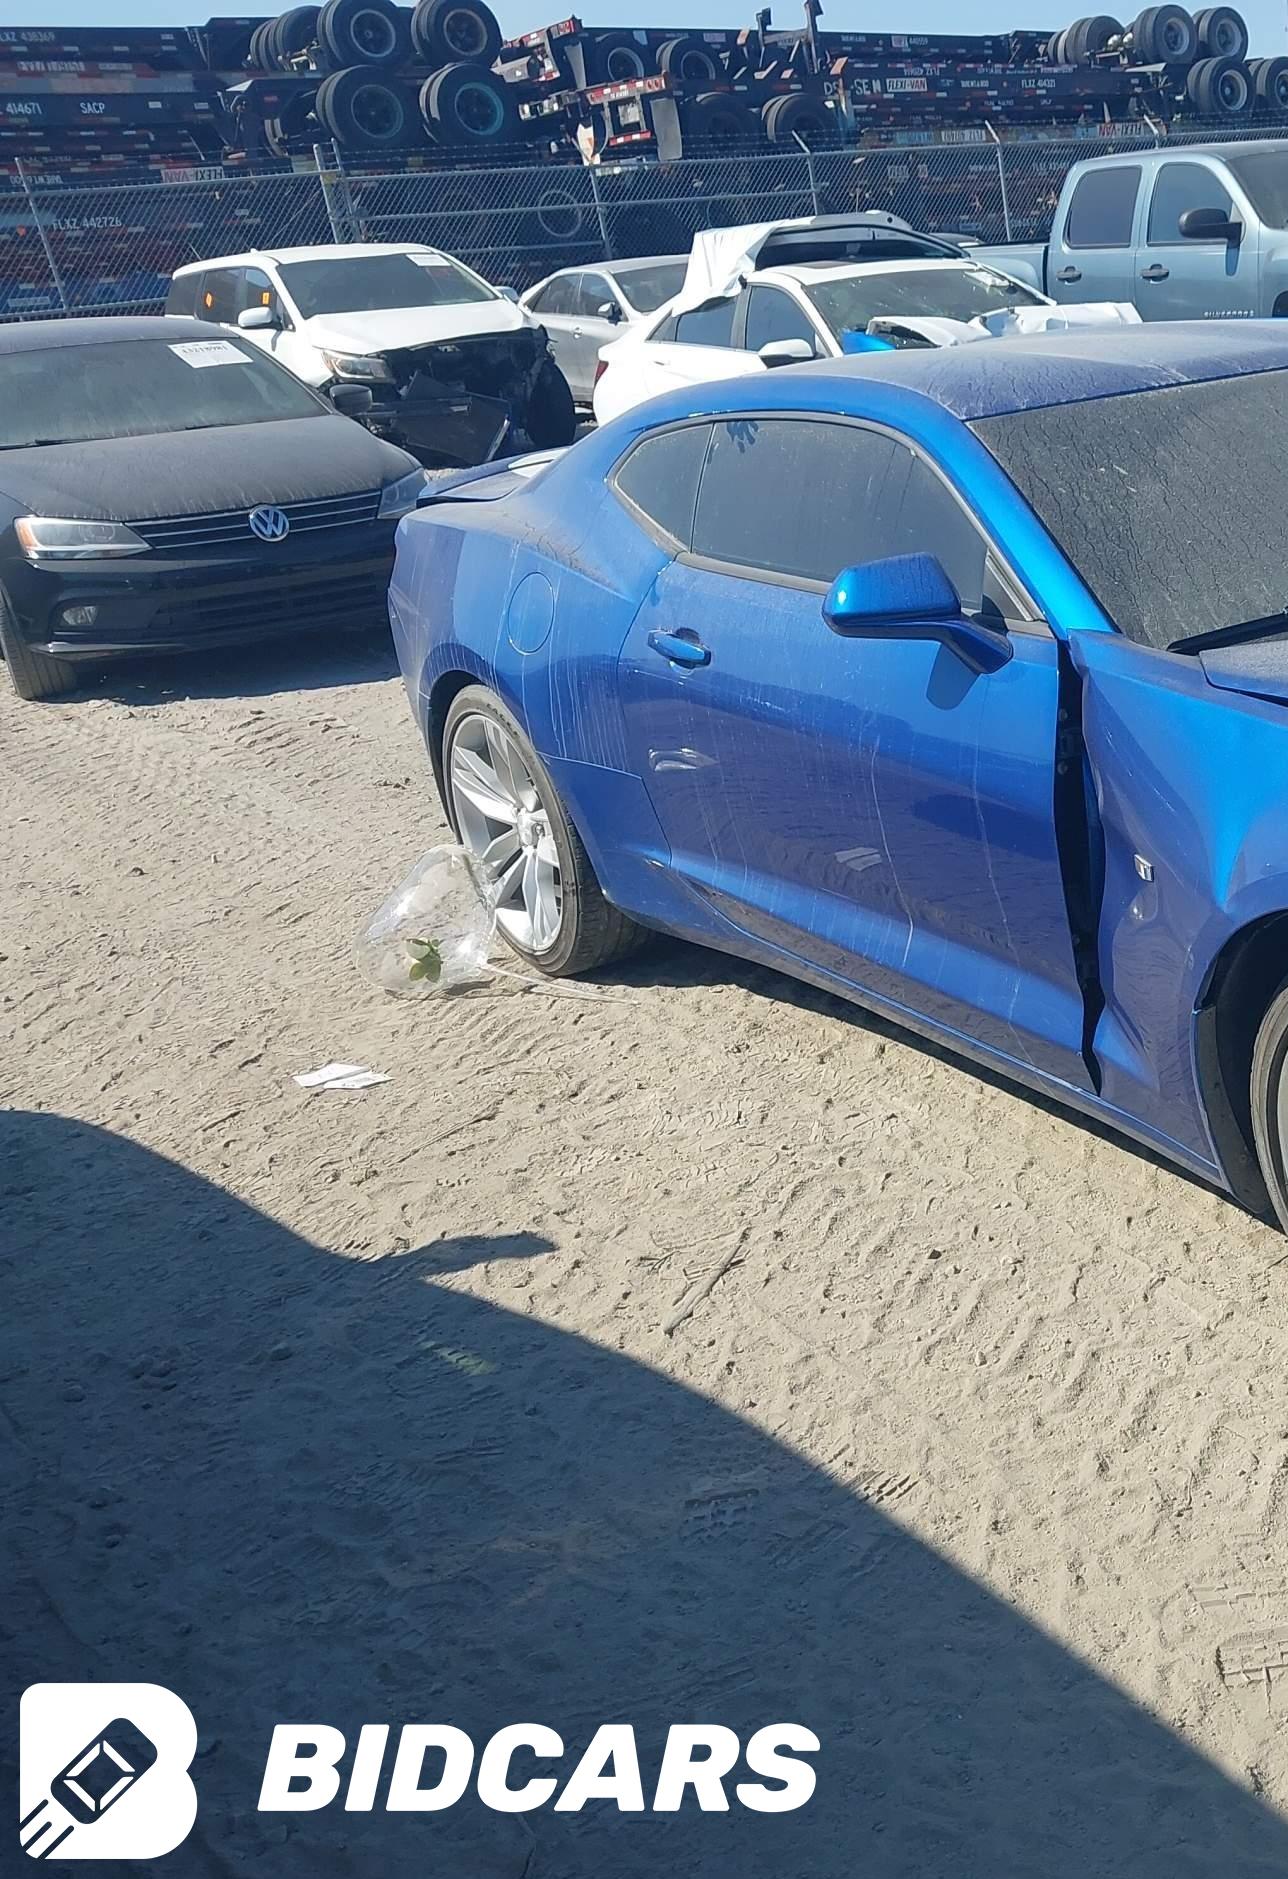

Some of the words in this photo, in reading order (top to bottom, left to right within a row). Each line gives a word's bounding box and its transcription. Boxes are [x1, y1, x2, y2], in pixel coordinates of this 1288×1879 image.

[887, 78, 927, 91] FLEXI-VAN
[80, 102, 105, 114] SACP
[164, 167, 223, 183] FLEXI-VAN
